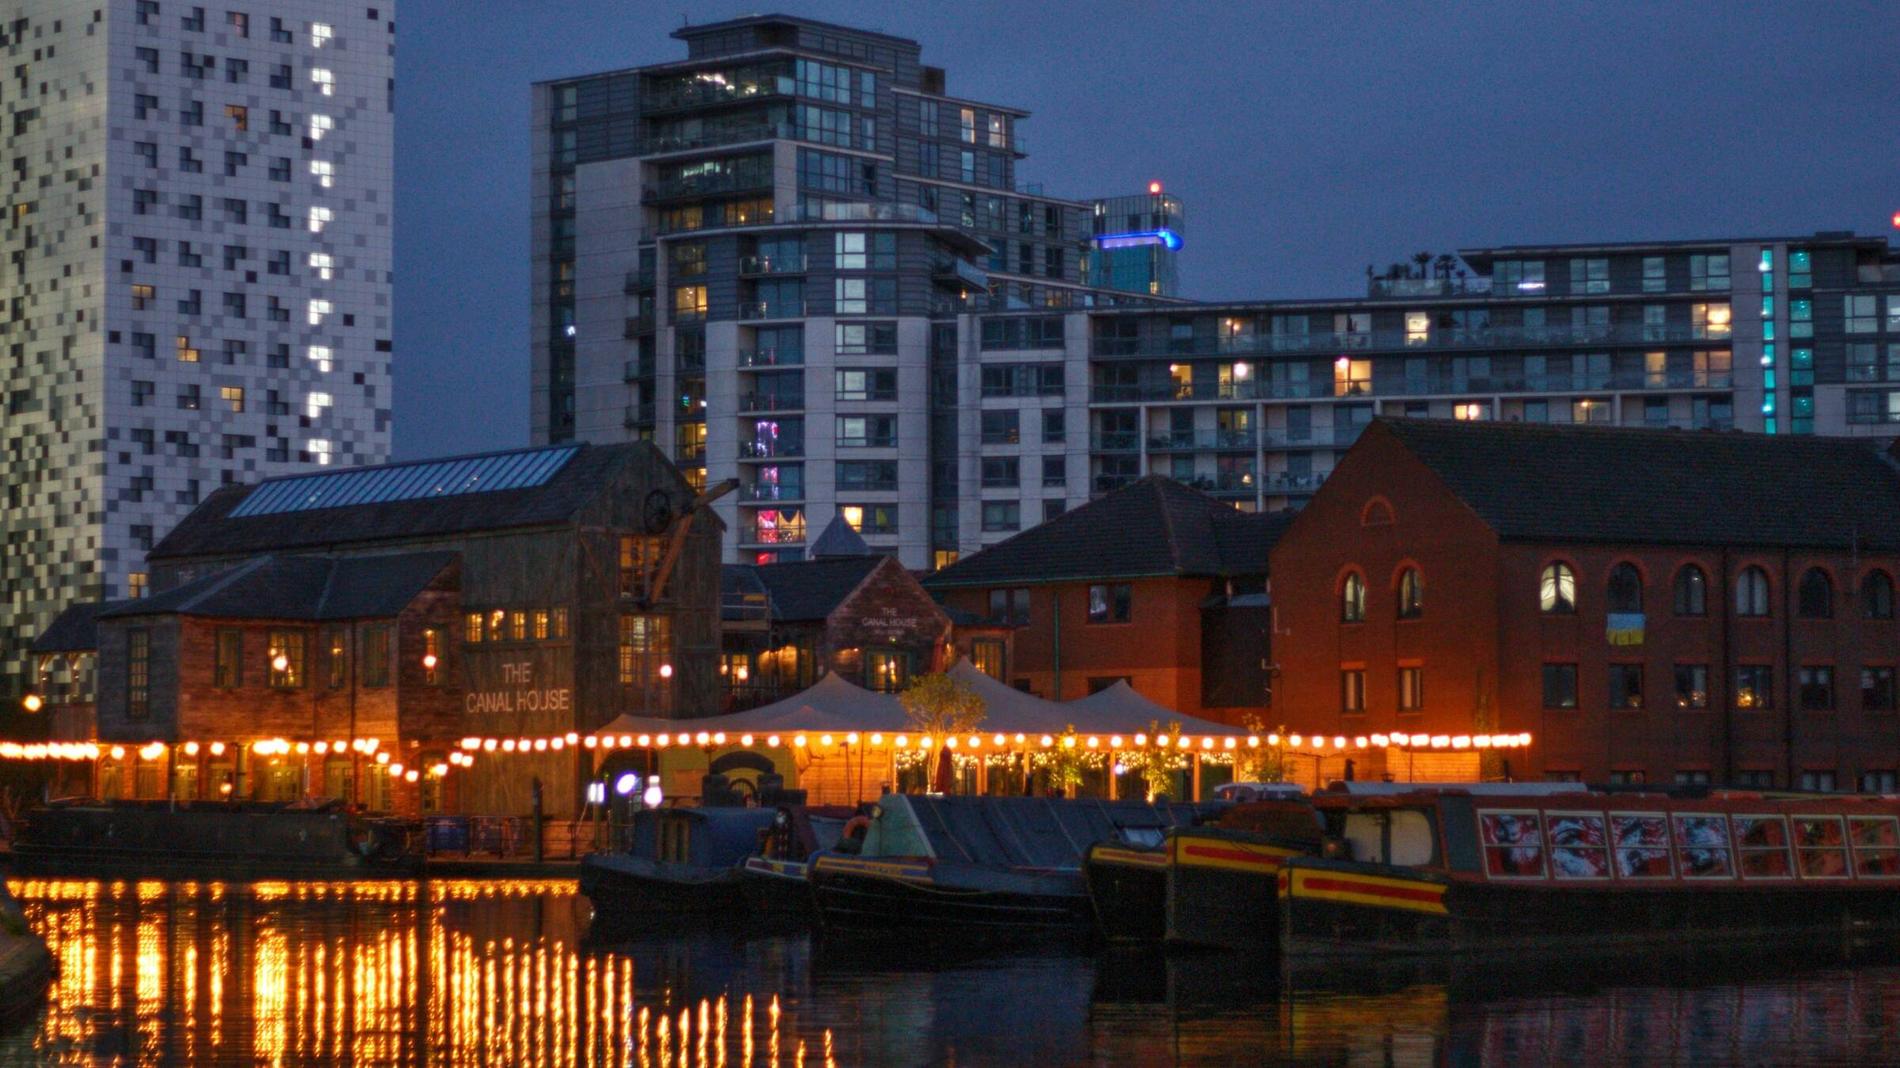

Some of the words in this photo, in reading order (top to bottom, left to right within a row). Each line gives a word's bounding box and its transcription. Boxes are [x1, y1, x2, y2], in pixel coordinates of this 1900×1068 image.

[881, 607, 897, 616] THE
[862, 617, 888, 626] CANAL
[889, 618, 917, 627] HOUSE
[502, 662, 532, 683] THE
[466, 692, 513, 712] CANAL
[517, 689, 569, 711] HOUSE
